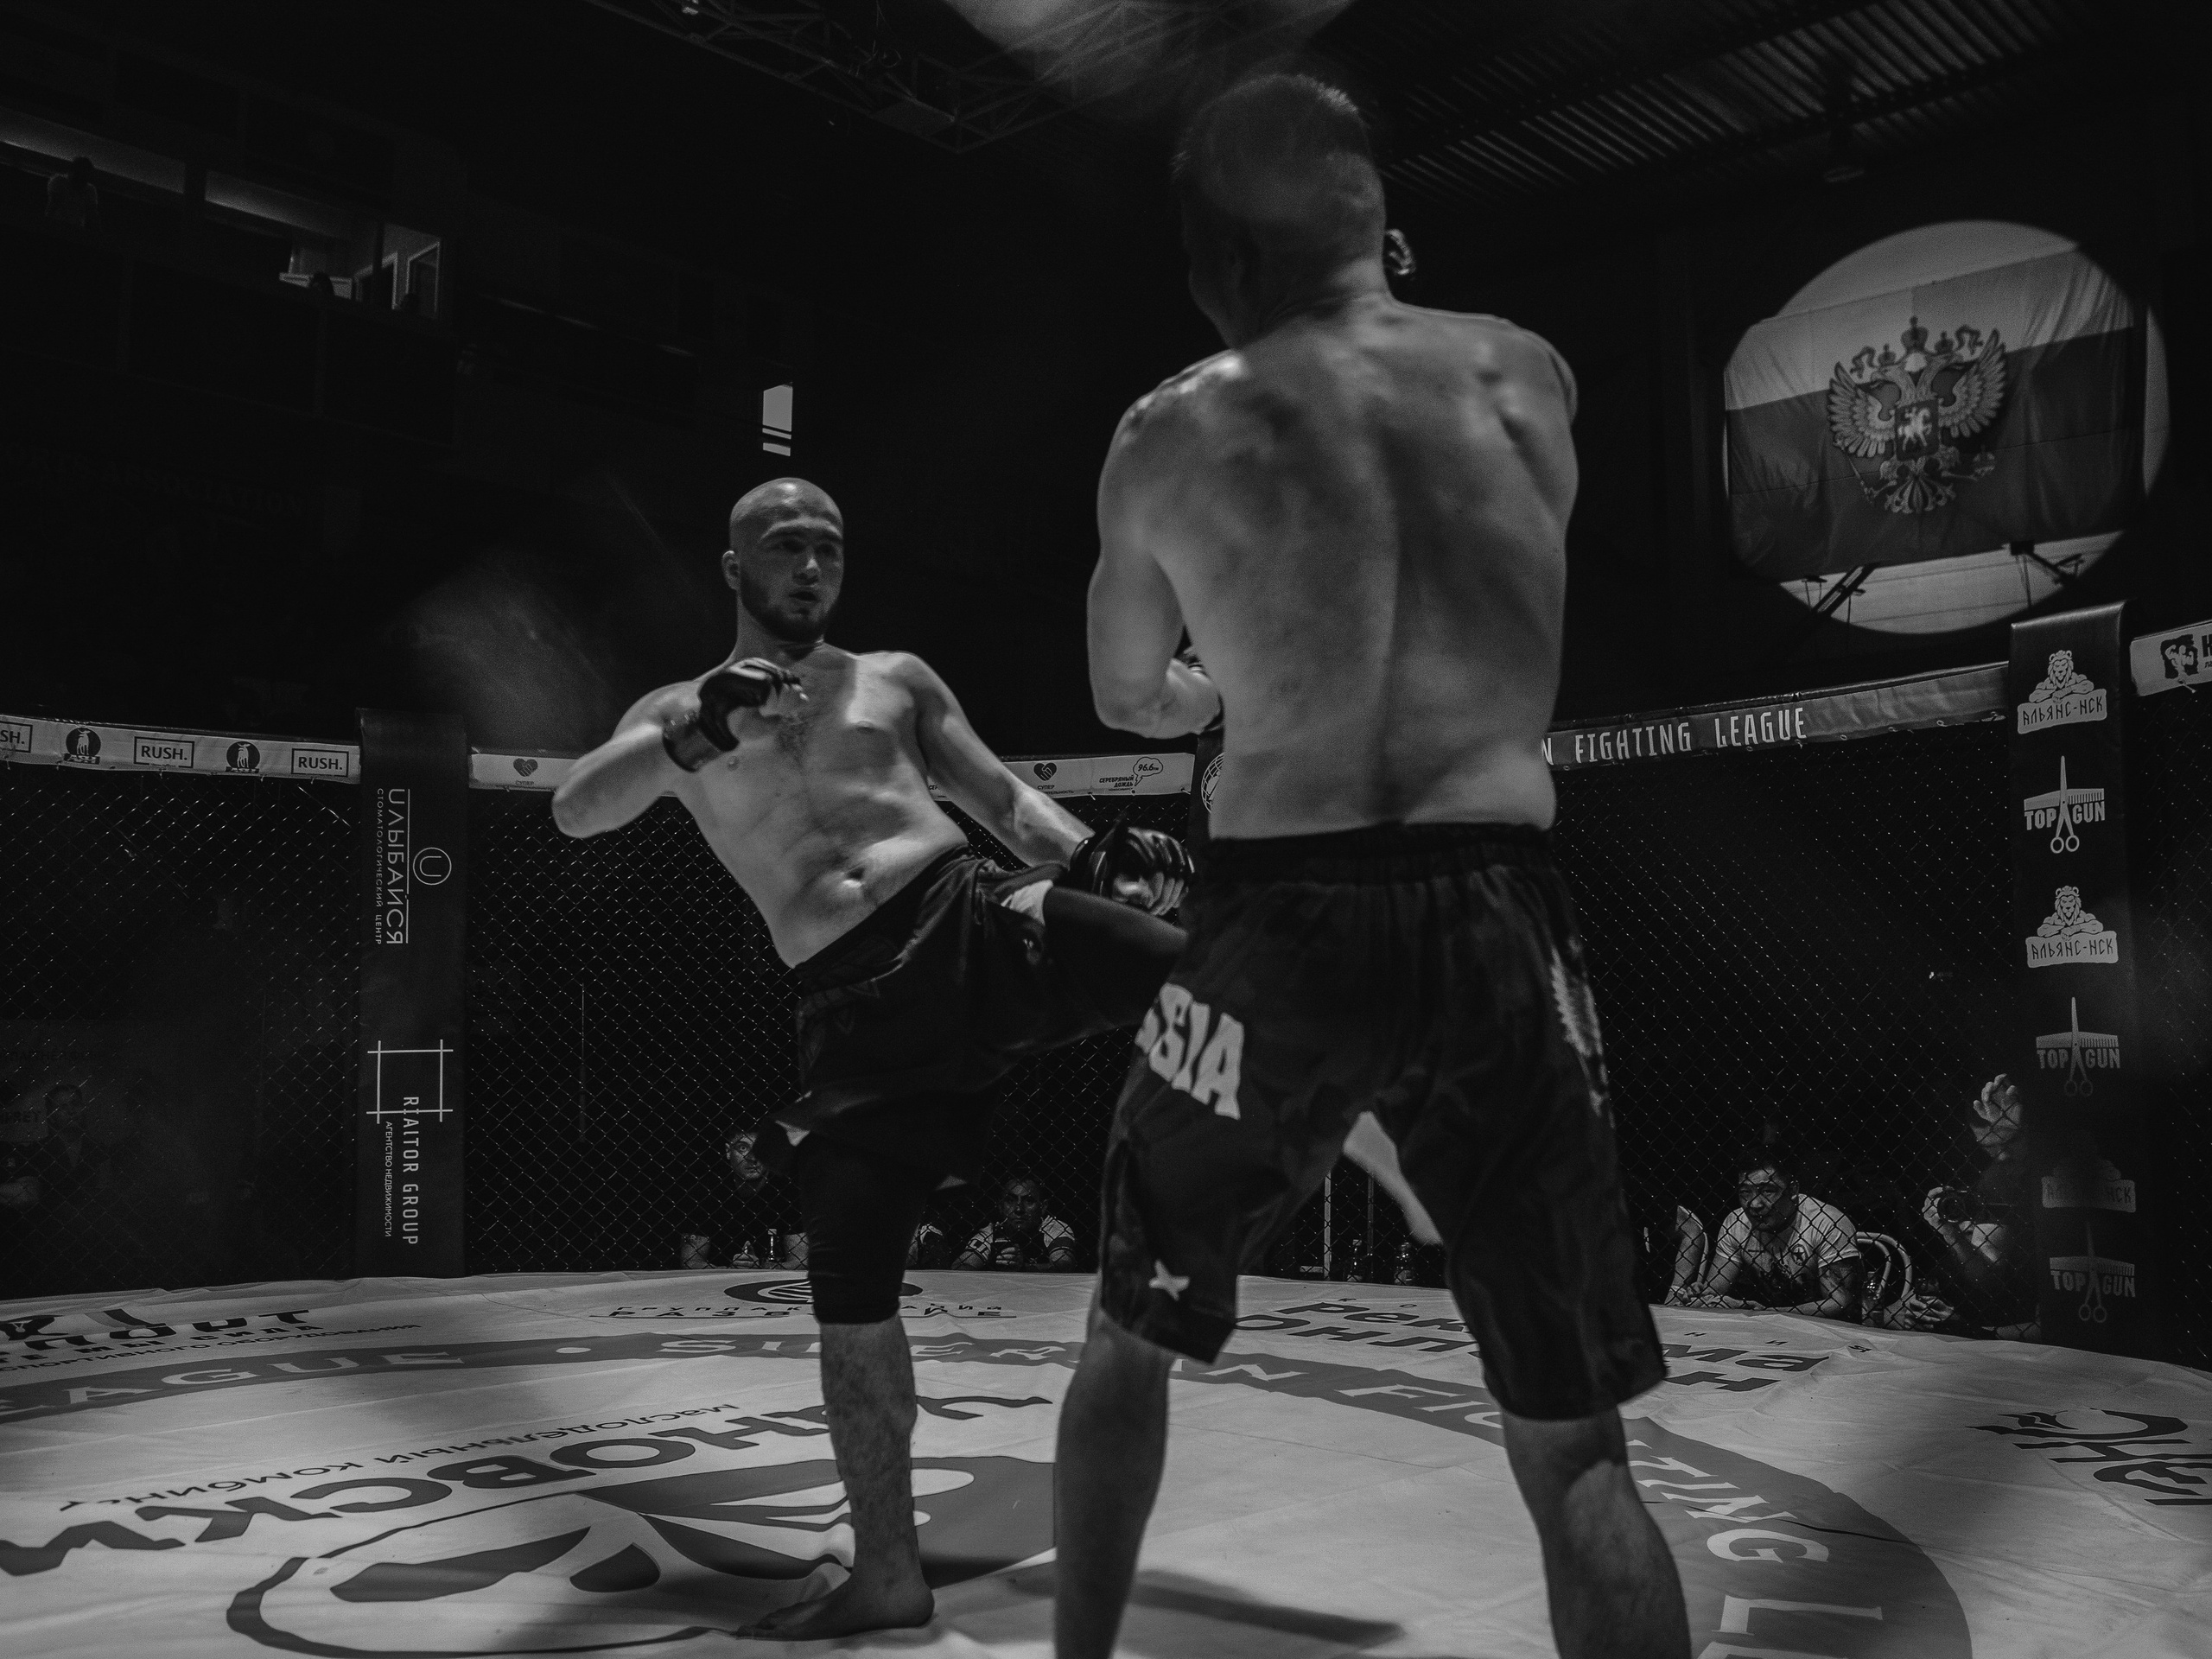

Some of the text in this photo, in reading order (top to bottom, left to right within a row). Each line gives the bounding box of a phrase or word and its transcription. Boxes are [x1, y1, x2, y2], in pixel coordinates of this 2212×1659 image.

[2022, 695, 2104, 727] АЛЬЯНС-НСК
[1574, 721, 1693, 764] FIGHTING
[1714, 706, 1807, 749] LEAGUE
[141, 745, 188, 761] RUSH.
[298, 756, 343, 771] RUSH.
[1099, 775, 1135, 784] СЕРЕБРЯНЫЙ
[2024, 800, 2106, 831] TOP GUN
[375, 788, 385, 907] СТОМАТОЛОГИЧЕСКИЙ
[2031, 938, 2113, 960] АЛЬЯНС-НСК
[2036, 1048, 2120, 1070] TOP GUN
[384, 1122, 393, 1237] АГЕНТСТВО НЕДВИЖИМОСТИ
[402, 1183, 419, 1245] GROUP
[2050, 1269, 2136, 1298] TOP GUN
[216, 1324, 423, 1346] ОБОРУДОВАНИЯ
